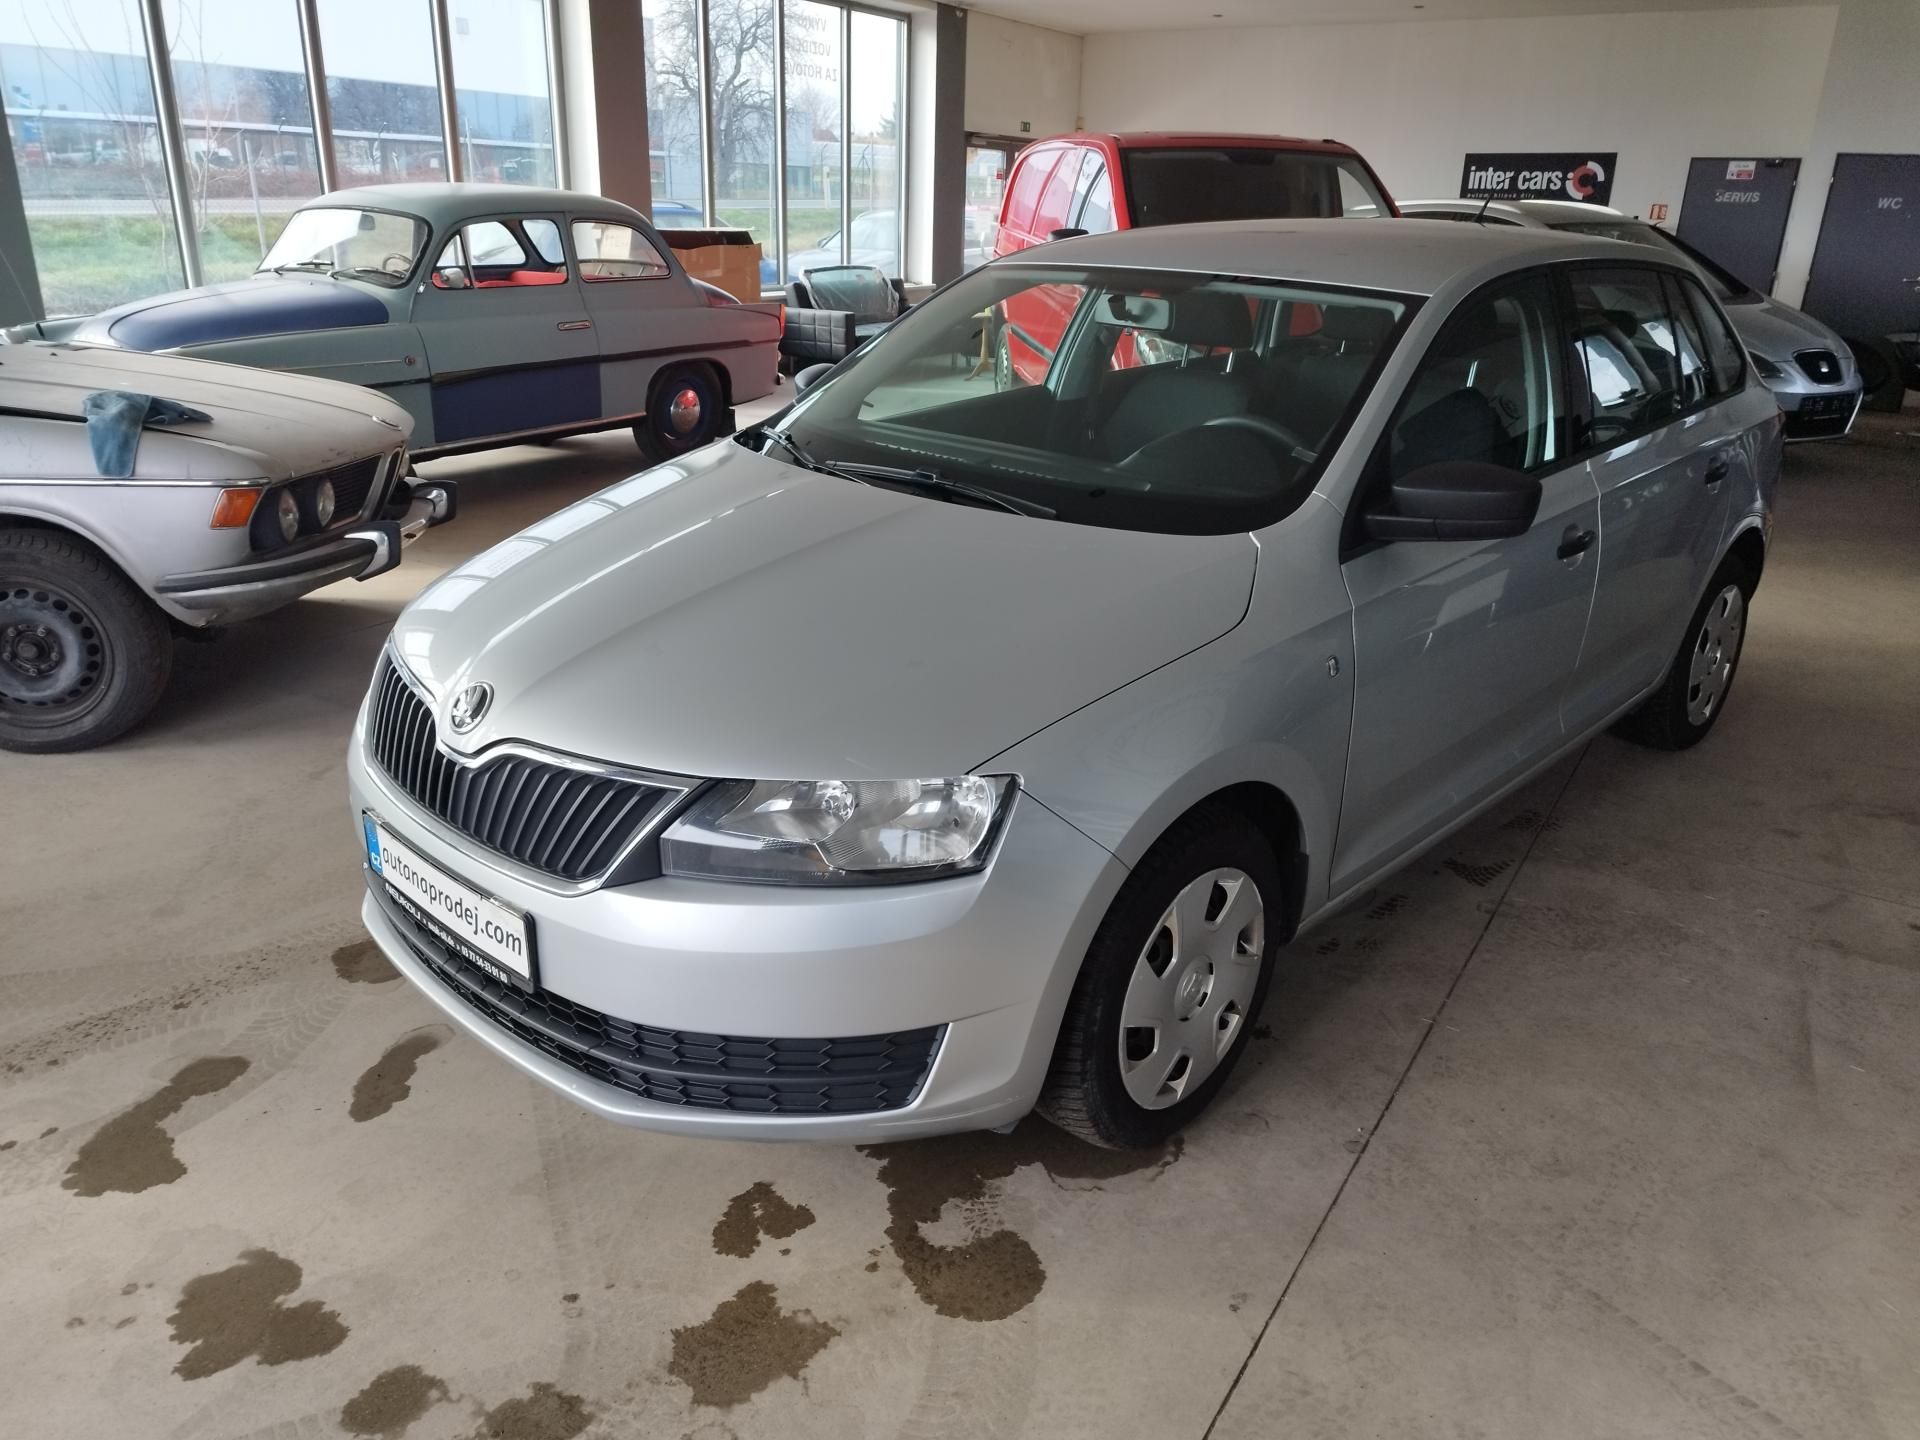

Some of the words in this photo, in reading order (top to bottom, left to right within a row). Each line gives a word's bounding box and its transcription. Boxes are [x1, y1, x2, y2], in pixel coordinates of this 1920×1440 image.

[1467, 166, 1515, 190] inter
[1517, 170, 1563, 191] cars
[1714, 190, 1760, 203] SERVIS
[1877, 197, 1903, 209] WC
[371, 851, 382, 869] CZ
[382, 846, 522, 956] autanaprodej.com
